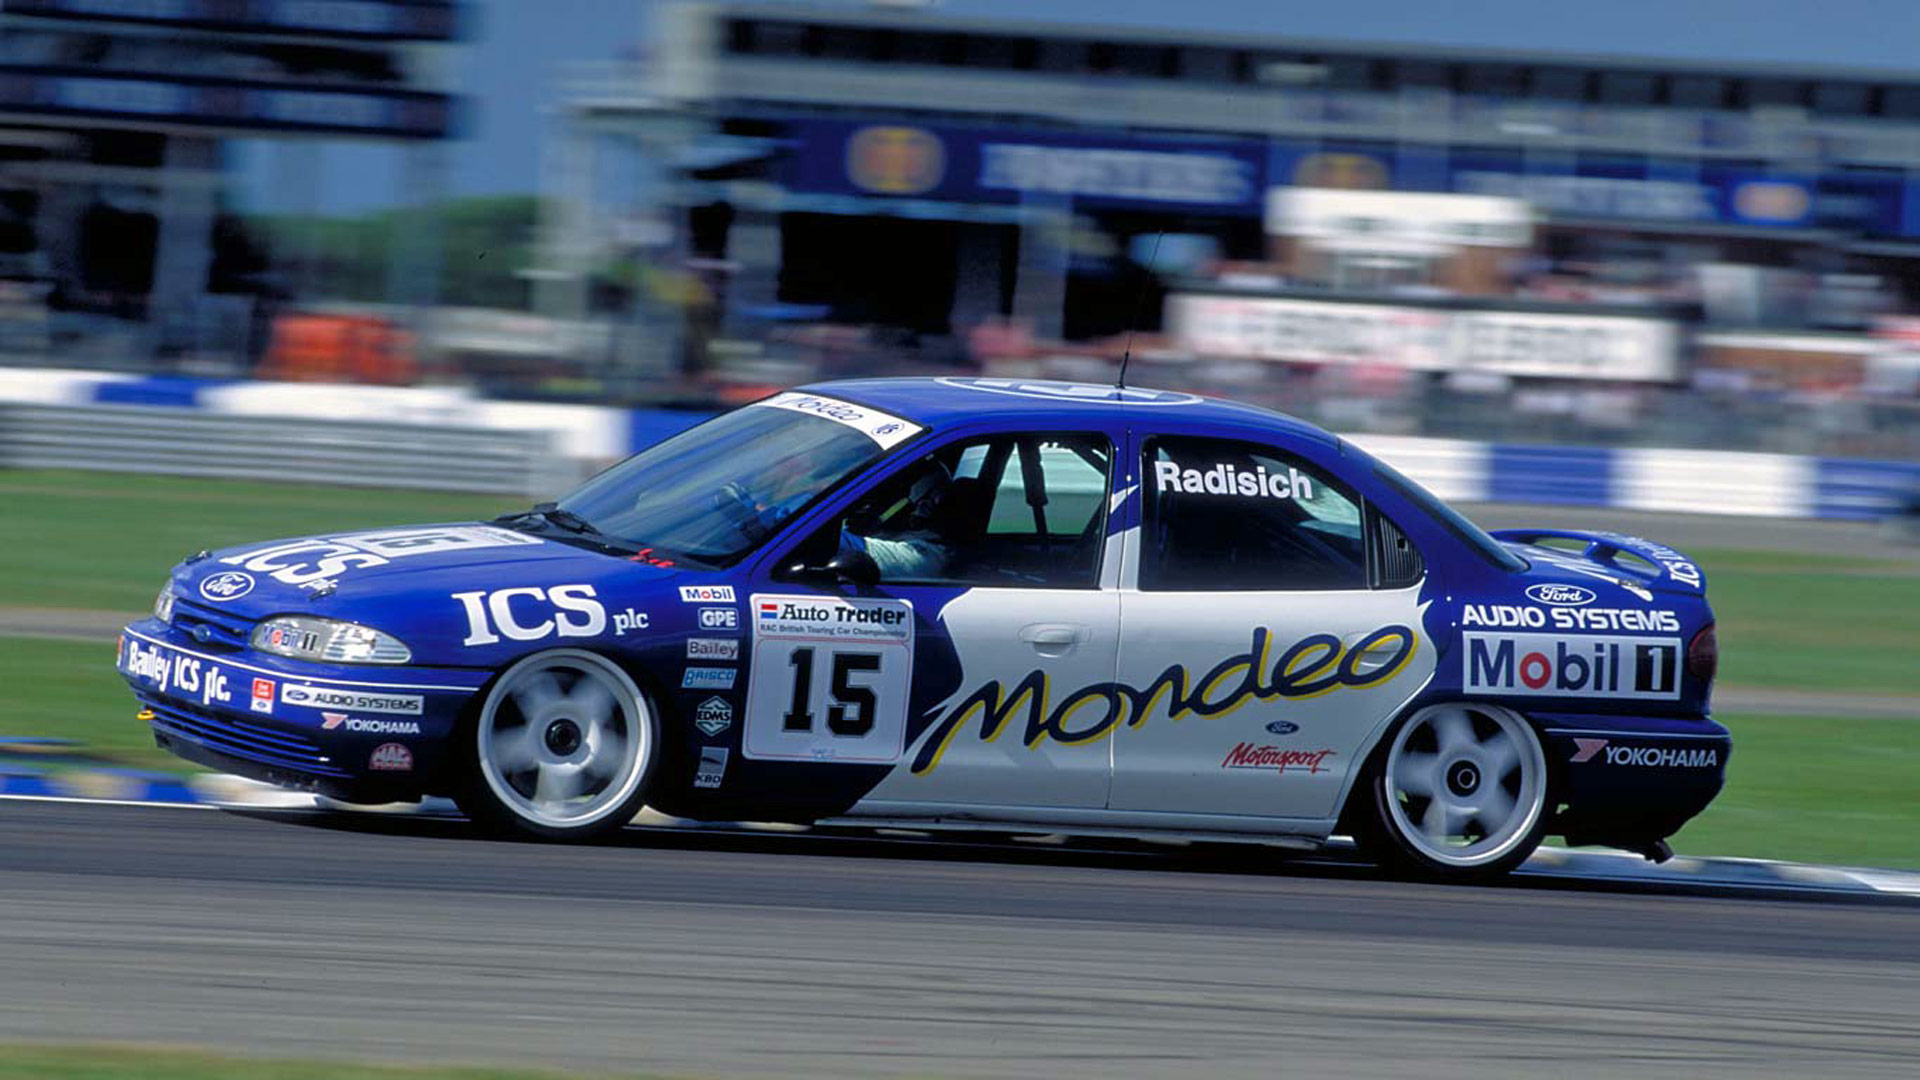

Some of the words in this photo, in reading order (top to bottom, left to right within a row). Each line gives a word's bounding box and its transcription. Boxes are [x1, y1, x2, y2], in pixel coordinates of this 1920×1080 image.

[1154, 461, 1313, 499] Radisich
[219, 540, 390, 584] ICS
[205, 573, 246, 596] Ford
[685, 588, 732, 600] Mobil
[1539, 586, 1583, 602] Ford
[451, 584, 607, 647] ICS
[612, 608, 649, 636] plc
[702, 611, 736, 627] GPE
[780, 604, 830, 622] Auto
[834, 607, 905, 625] Trader
[1462, 605, 1545, 628] AUDIO
[1551, 608, 1680, 632] SYSTEMS
[779, 624, 806, 633] British
[808, 625, 835, 636] Touring
[690, 641, 738, 656] Bailey
[128, 640, 171, 692] Bailey
[173, 655, 201, 692] ICS
[1470, 638, 1619, 692] Mobil
[314, 693, 354, 707] AUDIO
[358, 697, 418, 711] SYSTEMS
[782, 647, 881, 739] 15
[911, 625, 1418, 776] Mondeo
[345, 718, 420, 734] YOKOHAMA
[698, 711, 730, 721] EDMS
[1221, 742, 1337, 774] Motorsport
[1605, 747, 1717, 768] YOKOHAMA
